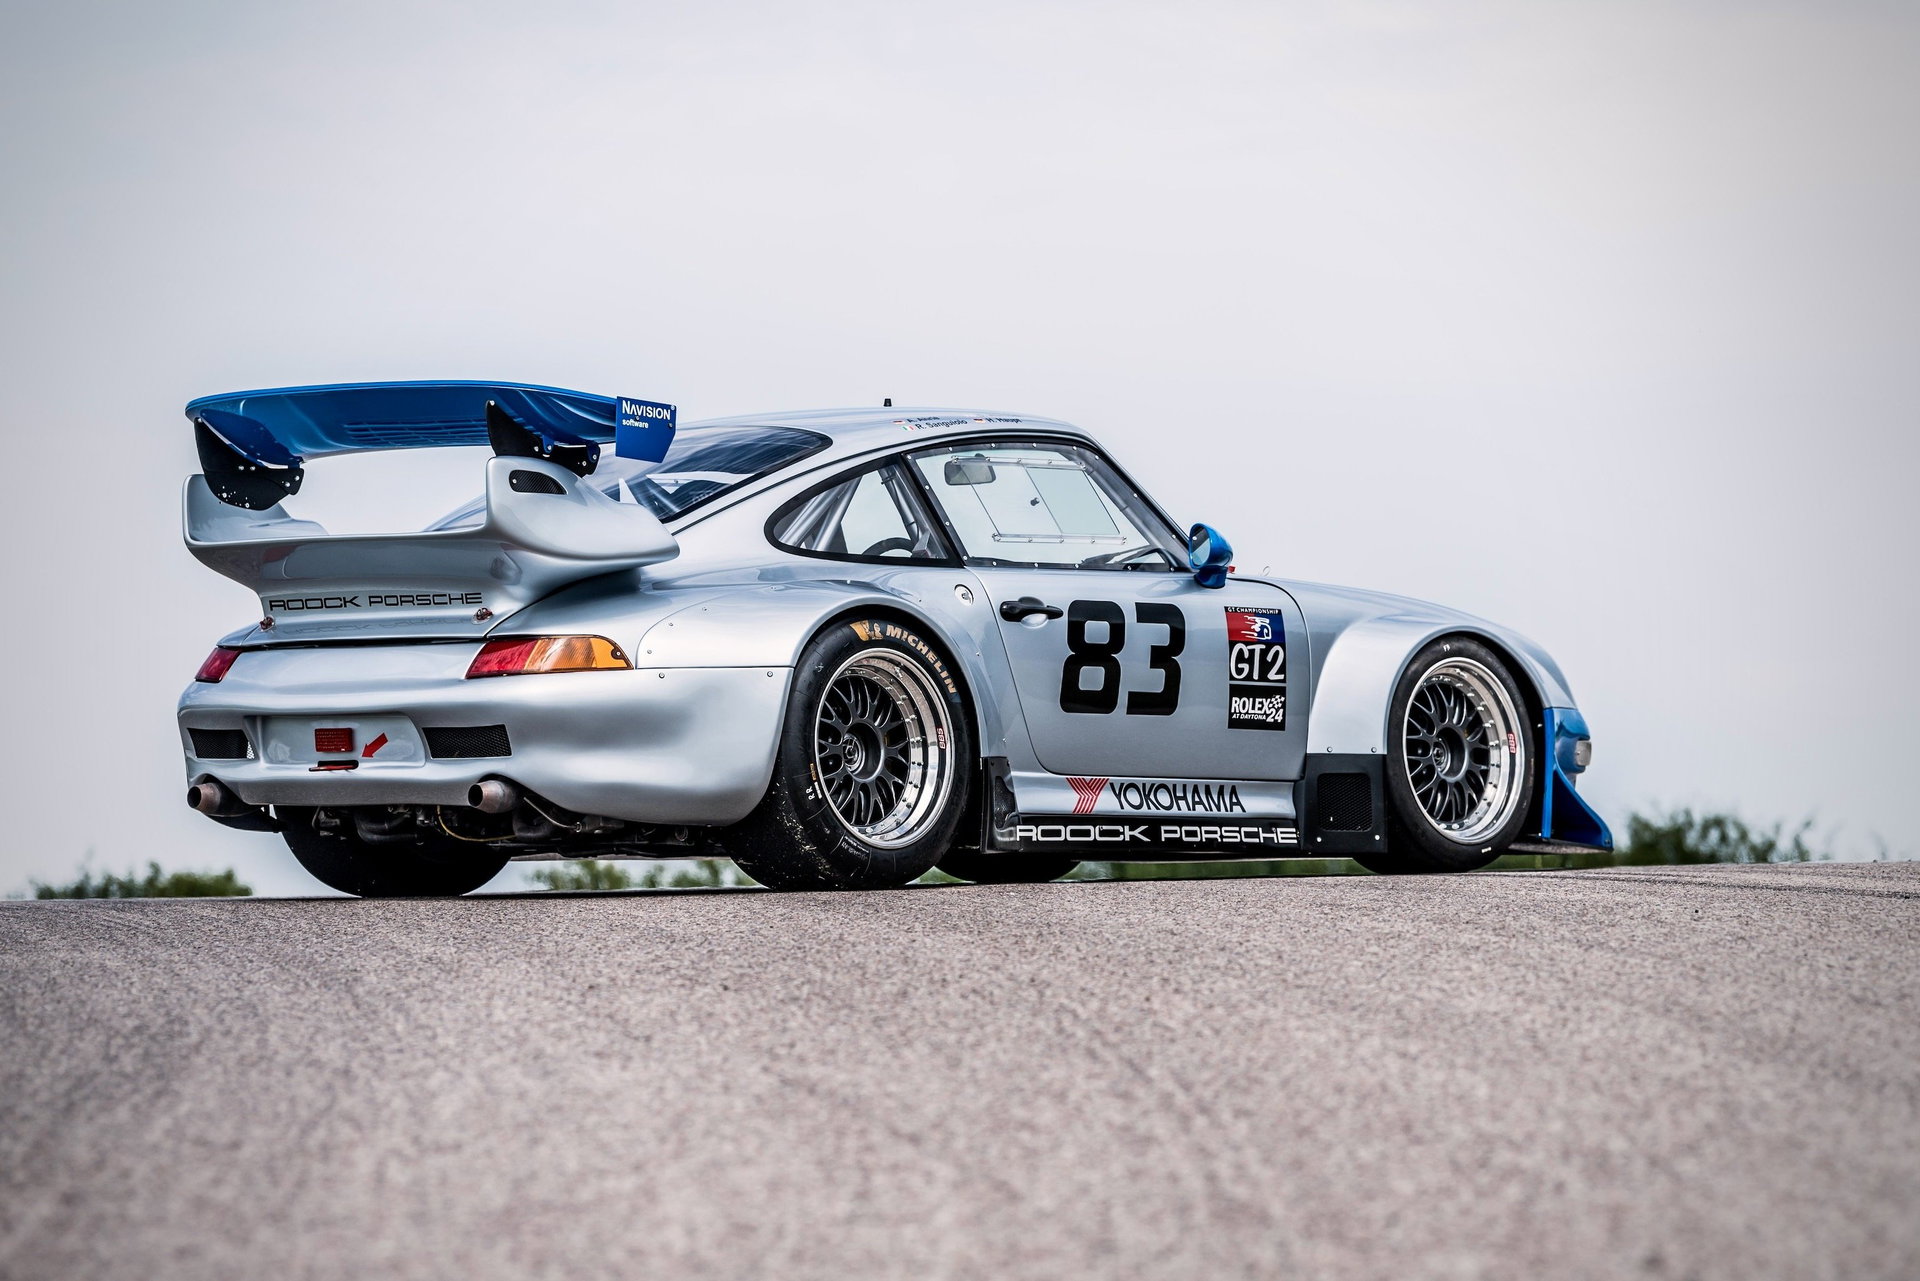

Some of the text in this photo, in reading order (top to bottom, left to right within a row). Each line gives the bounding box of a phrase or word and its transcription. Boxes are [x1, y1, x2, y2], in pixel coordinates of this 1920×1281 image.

[622, 400, 671, 420] NAVISION
[622, 419, 649, 429] software
[269, 592, 483, 611] ROOCK PORSCHE
[1236, 607, 1279, 615] CHAMPIONSHIP
[886, 624, 957, 694] MICHELIN
[1059, 599, 1186, 716] 83
[1230, 643, 1285, 680] GT2
[1231, 696, 1284, 723] ROLEX 24
[936, 727, 946, 750] BBS
[1109, 782, 1247, 813] YOKOHAMA
[1016, 825, 1298, 844] ROOCK PORSCHE
